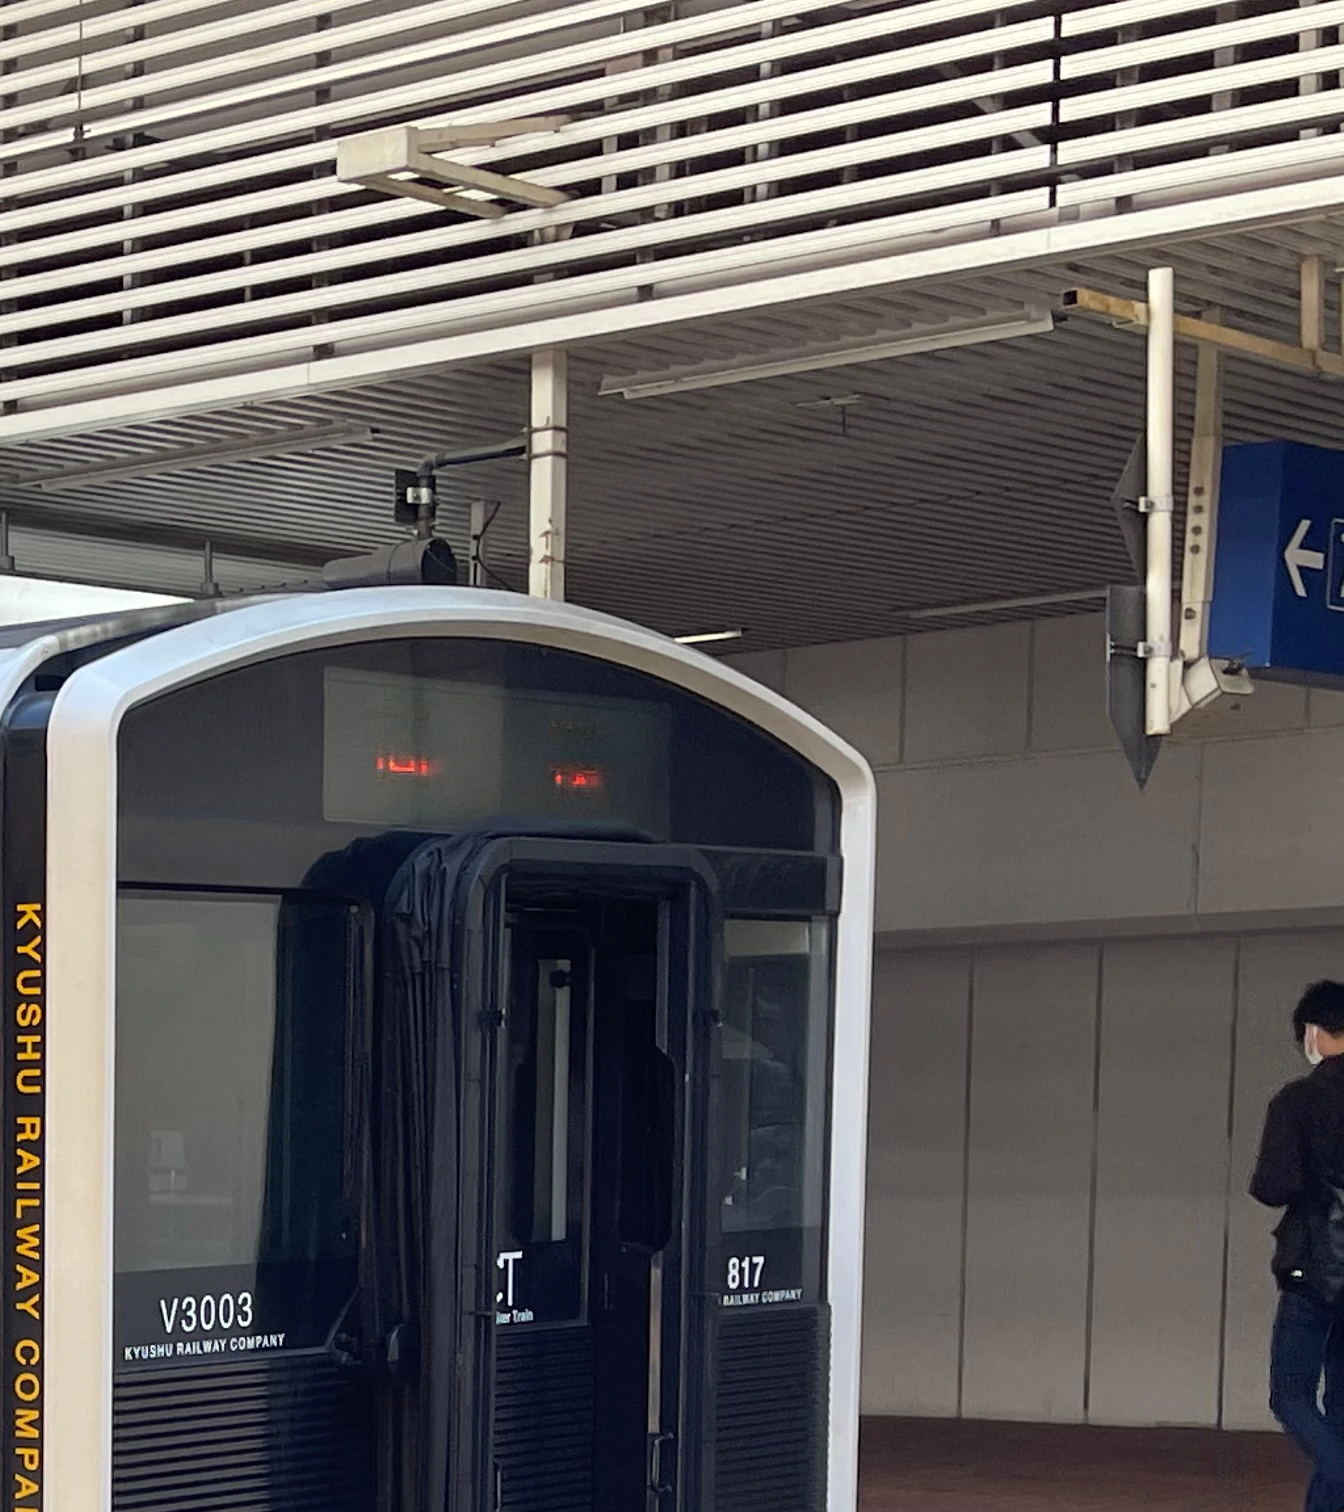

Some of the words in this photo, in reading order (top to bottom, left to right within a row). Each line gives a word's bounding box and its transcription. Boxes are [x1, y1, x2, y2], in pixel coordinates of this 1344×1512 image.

[15, 902, 42, 1094] KYUSHU
[14, 1116, 42, 1320] RAILWAY
[727, 1255, 765, 1290] 817
[159, 1291, 254, 1334] V3003
[761, 1288, 803, 1304] COMPANY
[124, 1342, 174, 1361] KYUSHU
[176, 1338, 228, 1356] RAILWAY
[229, 1333, 286, 1351] COMPANY
